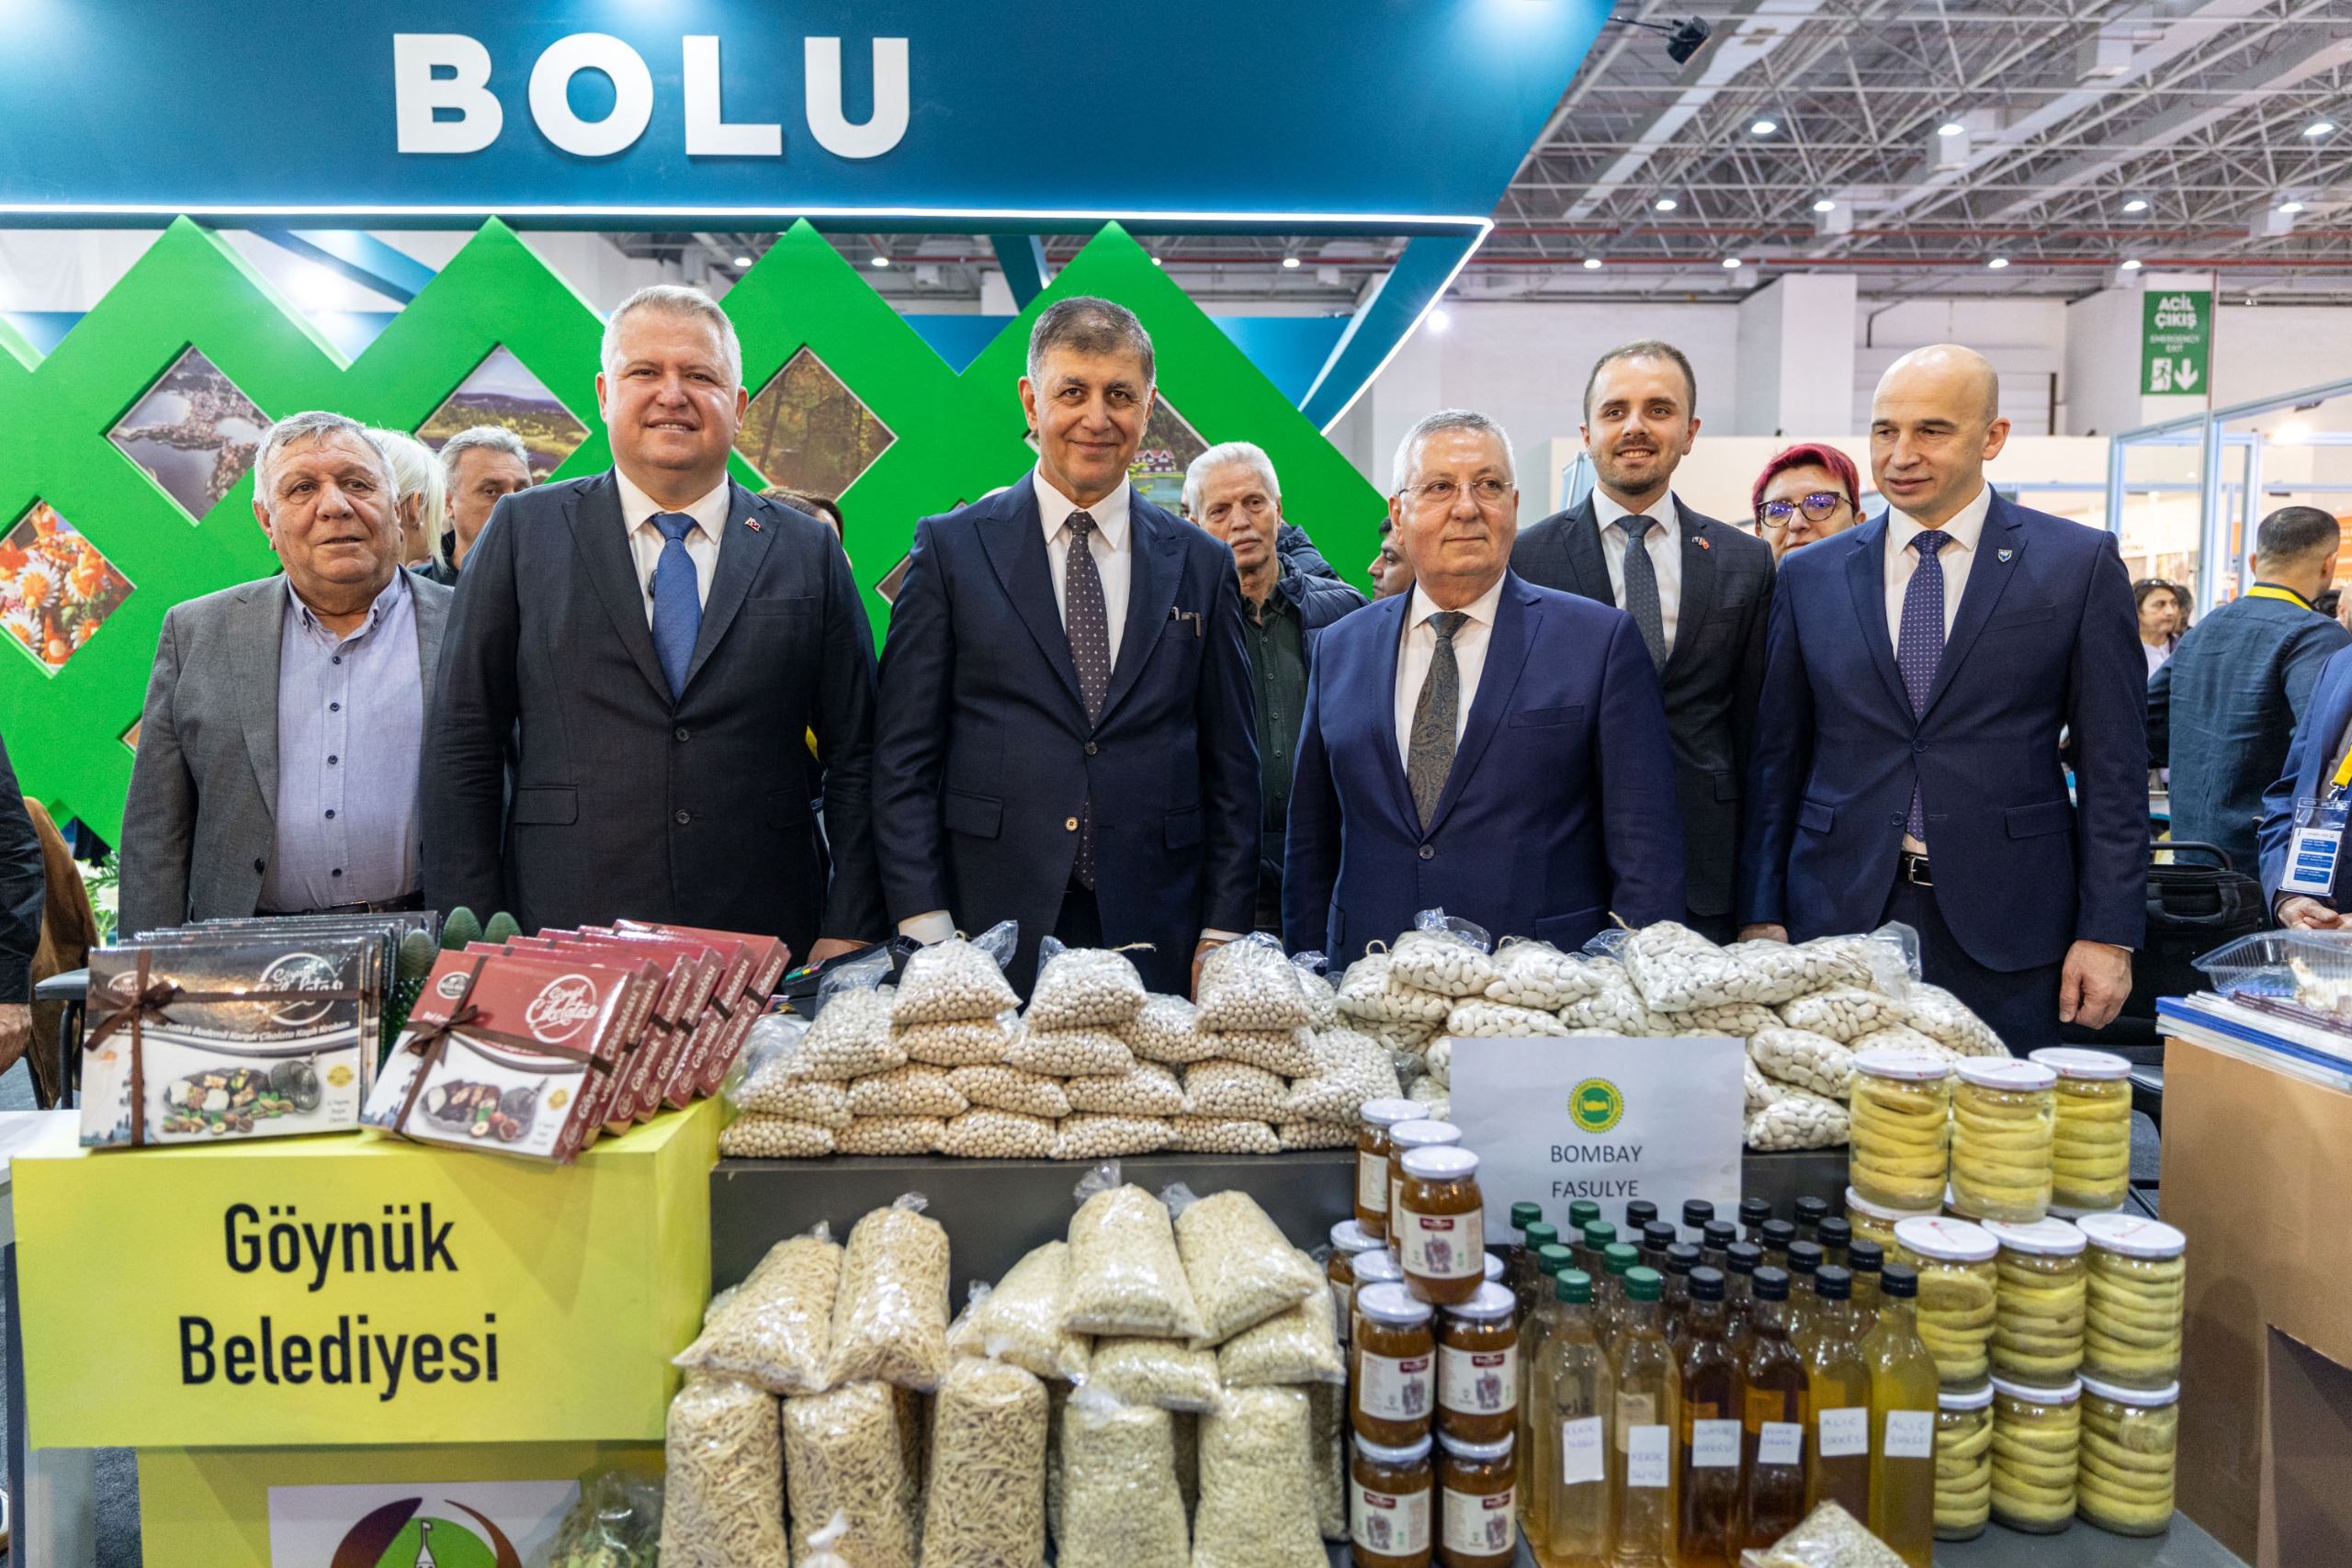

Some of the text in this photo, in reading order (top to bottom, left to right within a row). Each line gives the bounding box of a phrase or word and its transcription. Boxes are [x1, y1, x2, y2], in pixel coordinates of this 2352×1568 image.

[393, 32, 910, 159] BOLU
[2154, 311, 2197, 329] ÇIKIŞ
[2158, 293, 2195, 310] ACİL
[693, 1021, 719, 1068] Göynük
[723, 1013, 750, 1058] Göynük
[630, 1040, 661, 1091] Göynük
[579, 1070, 605, 1118] Göynü
[1551, 1145, 1643, 1163] BOMBAY
[1552, 1180, 1639, 1199] FASULYE
[225, 1202, 458, 1292] Göynük
[179, 1314, 499, 1403] Belediyesi
